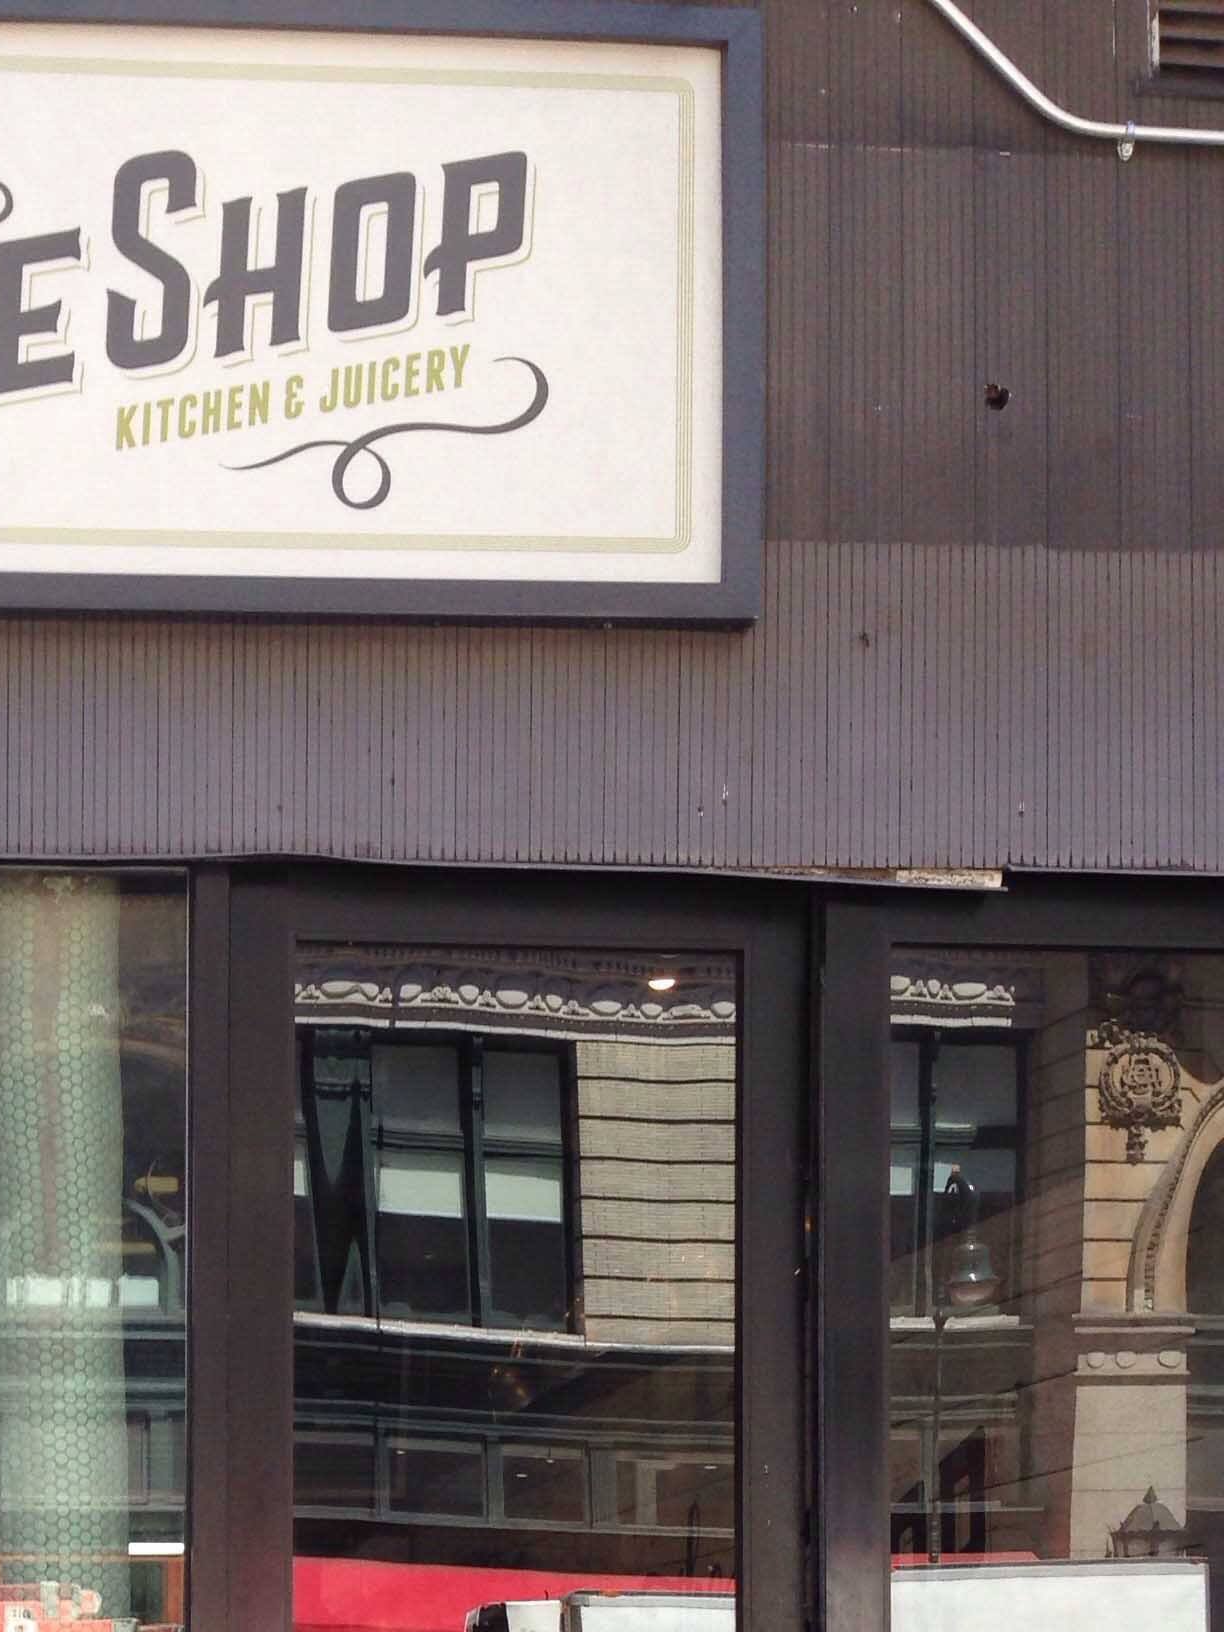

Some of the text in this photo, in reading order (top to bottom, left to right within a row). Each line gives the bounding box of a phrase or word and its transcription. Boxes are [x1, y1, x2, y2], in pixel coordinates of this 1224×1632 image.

[102, 149, 532, 372] SHOP
[114, 343, 473, 453] KITCHEN & JUICERY
